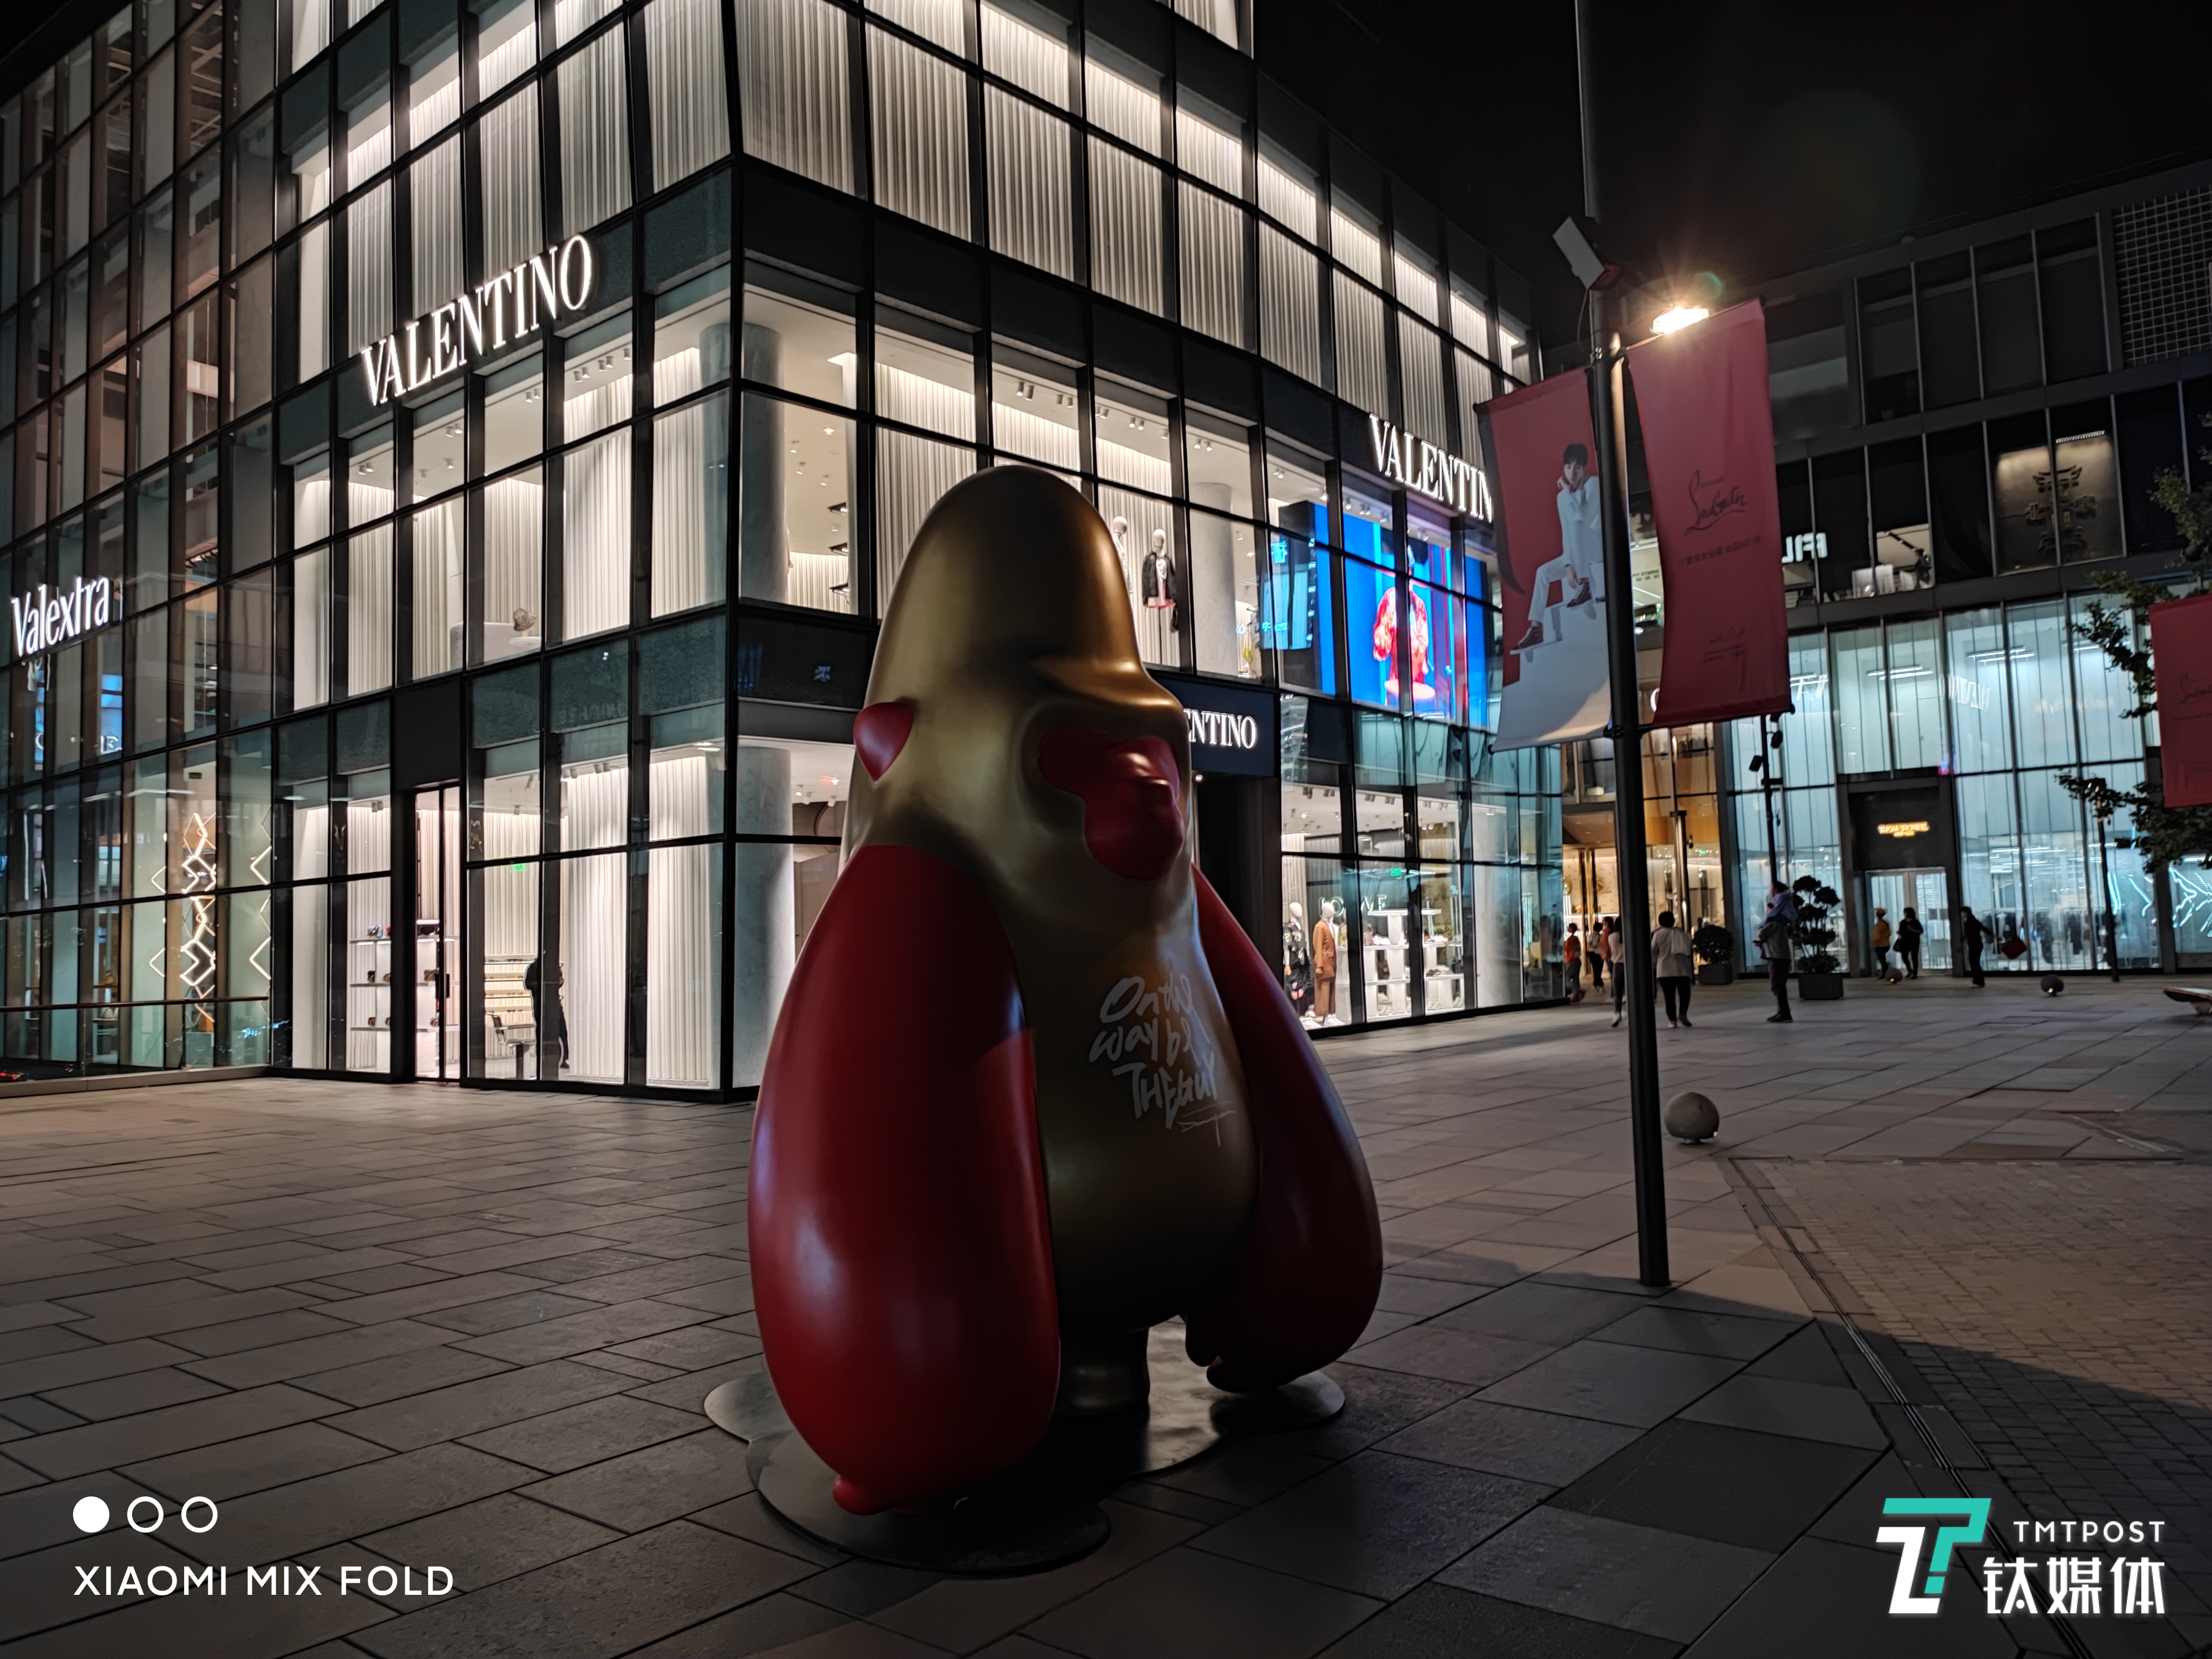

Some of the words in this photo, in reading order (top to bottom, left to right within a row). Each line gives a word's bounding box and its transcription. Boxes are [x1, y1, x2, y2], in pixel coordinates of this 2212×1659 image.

[361, 234, 592, 406] VALENTINO
[1369, 413, 1493, 523] VALENTIN
[11, 576, 110, 658] Valextra
[1183, 708, 1257, 749] NTINO
[1089, 1018, 1158, 1062] way
